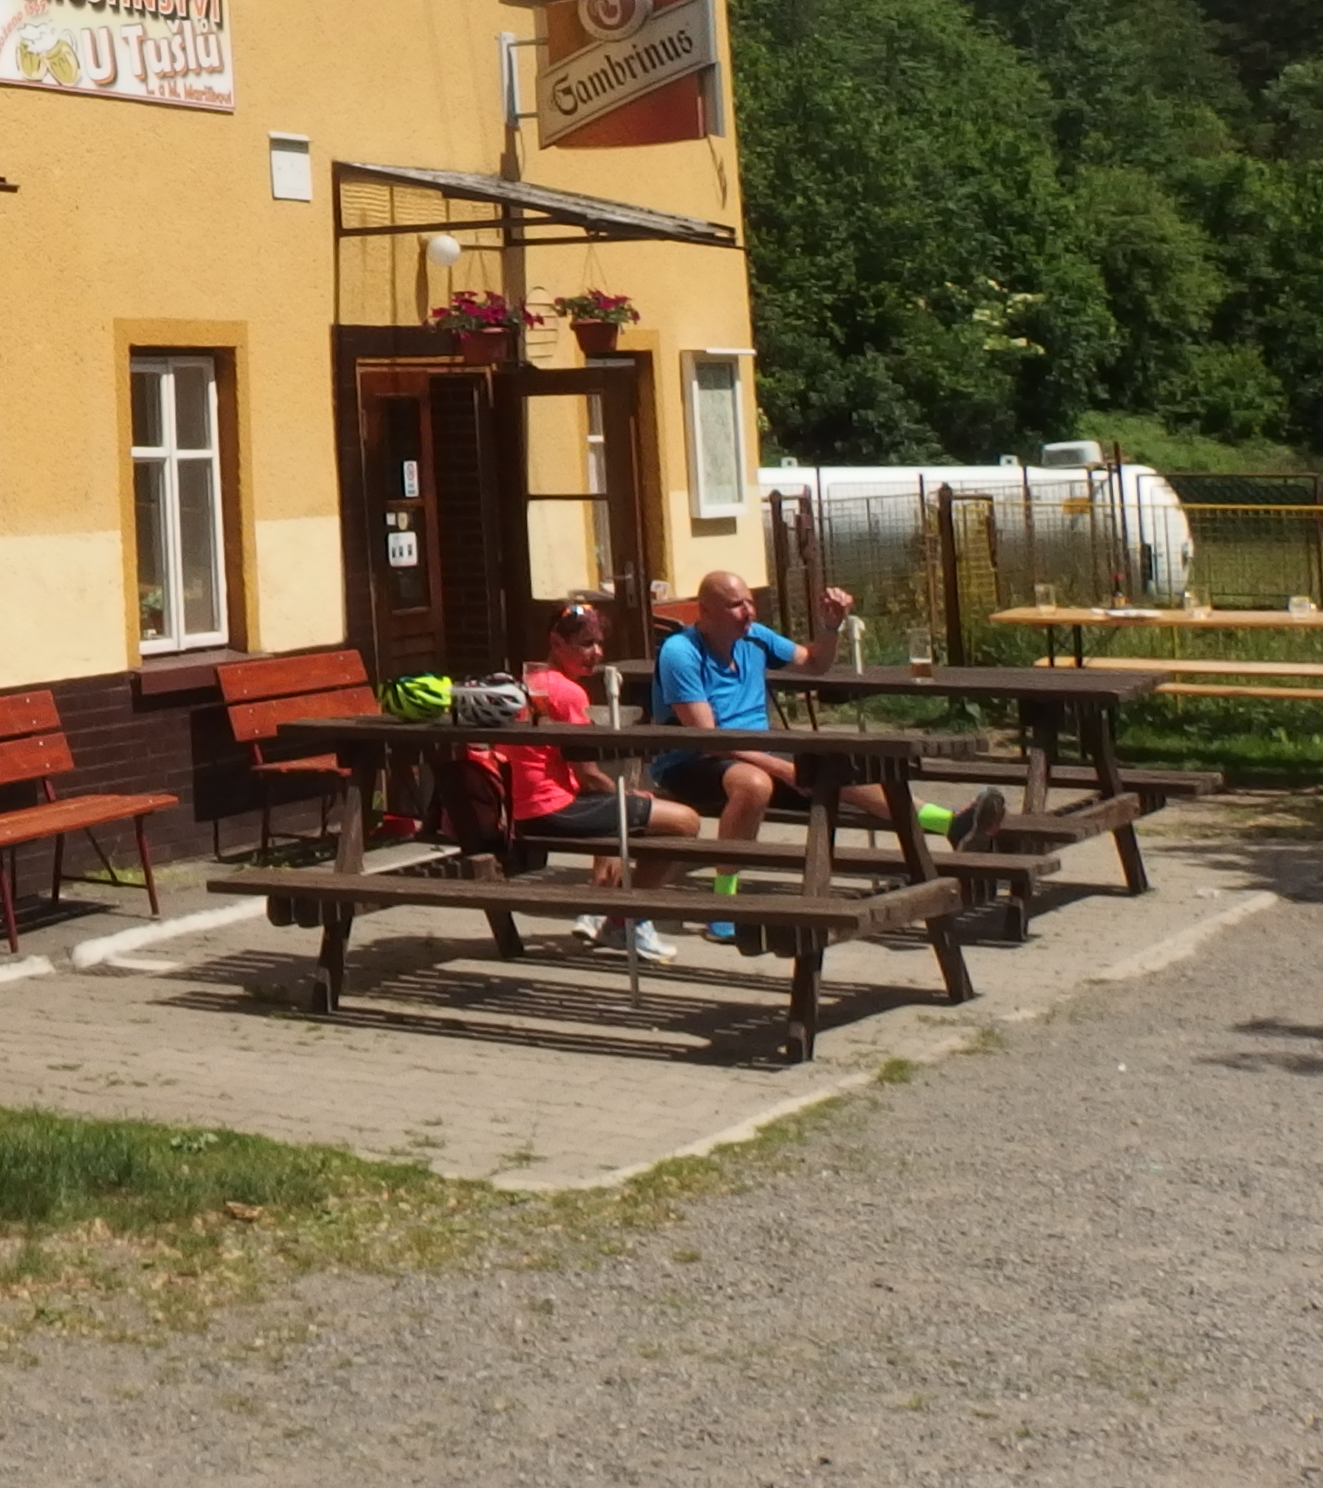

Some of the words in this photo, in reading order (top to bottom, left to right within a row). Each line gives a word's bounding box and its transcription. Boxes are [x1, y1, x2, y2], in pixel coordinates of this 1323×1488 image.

[81, 26, 117, 85] U
[120, 19, 223, 80] Tušlů
[551, 29, 694, 116] Gambrinus
